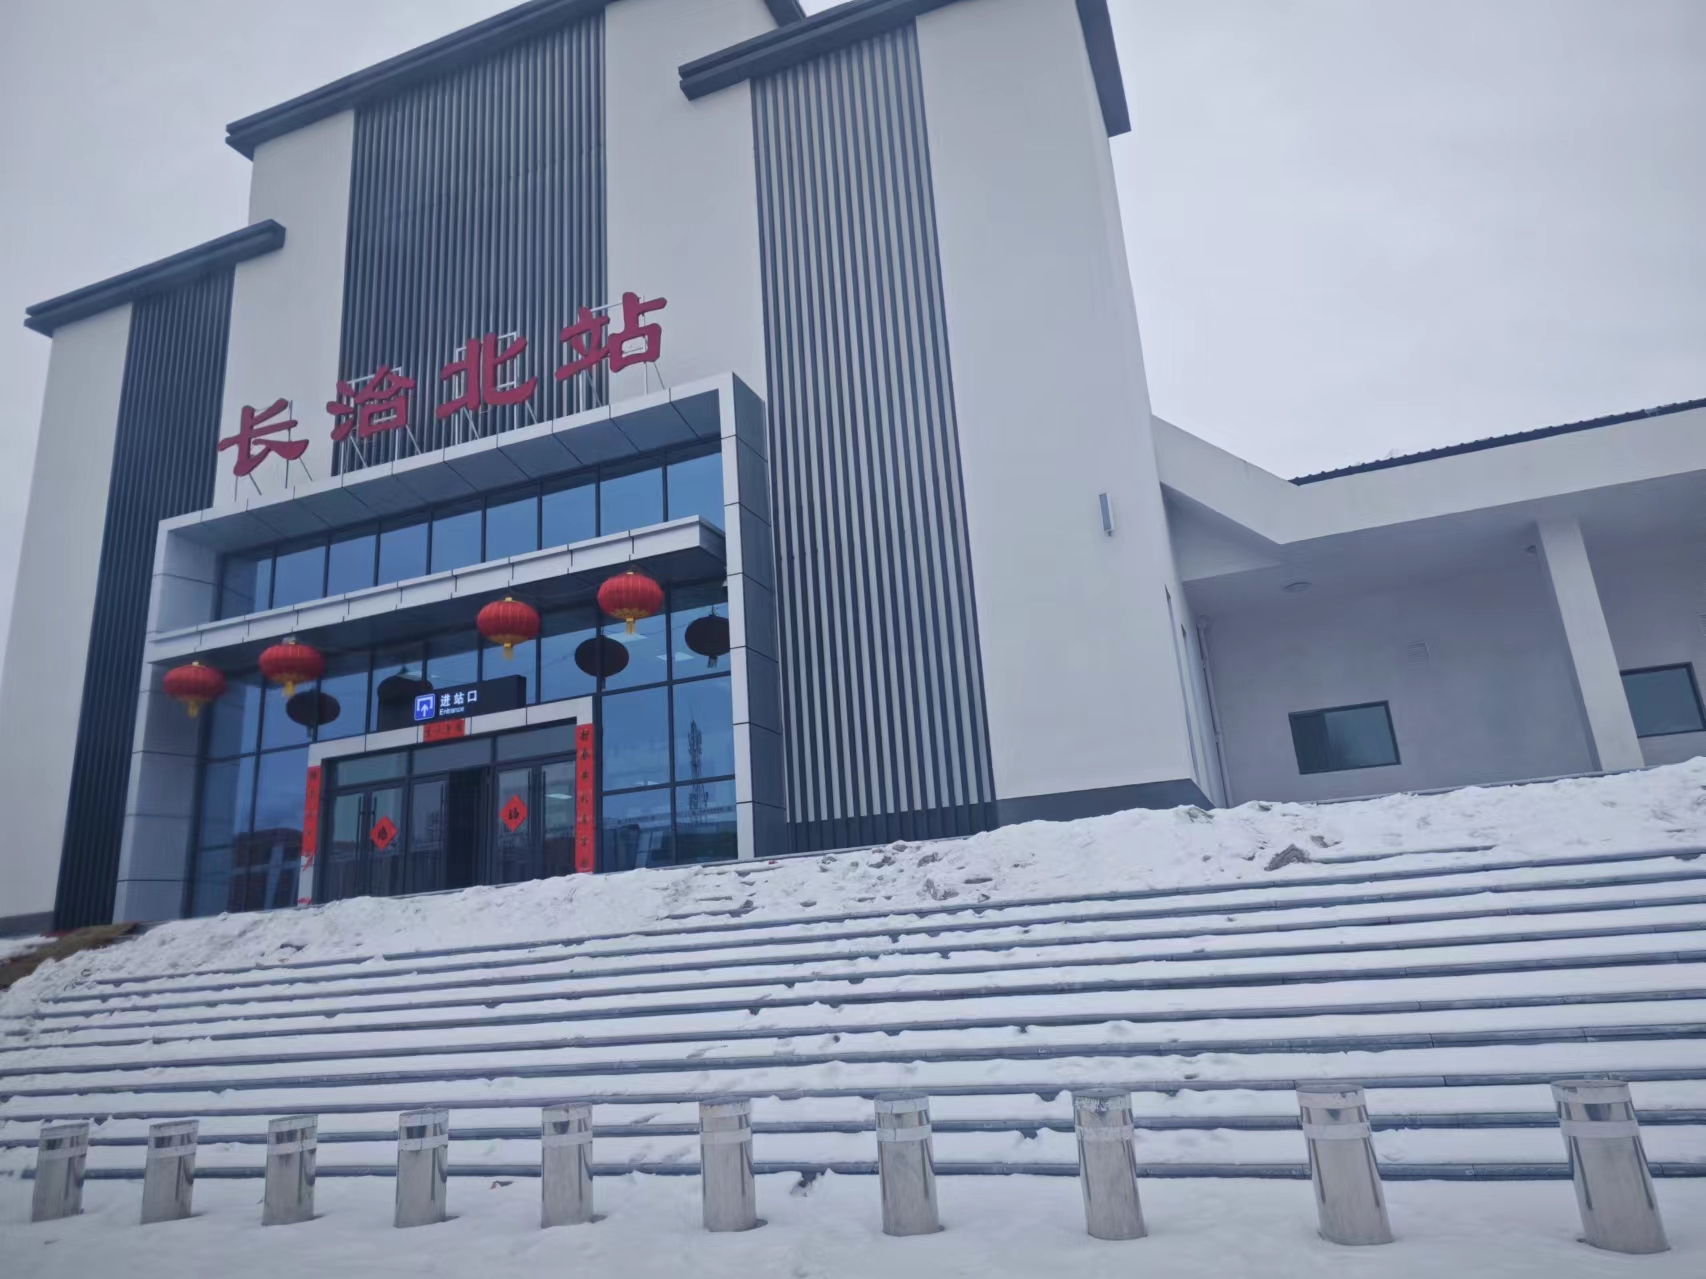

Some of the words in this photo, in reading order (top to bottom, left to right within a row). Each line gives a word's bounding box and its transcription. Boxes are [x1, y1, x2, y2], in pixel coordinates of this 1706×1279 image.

[217, 291, 667, 477] 长治北站
[440, 690, 477, 707] 进站口
[439, 706, 464, 715] Entrance
